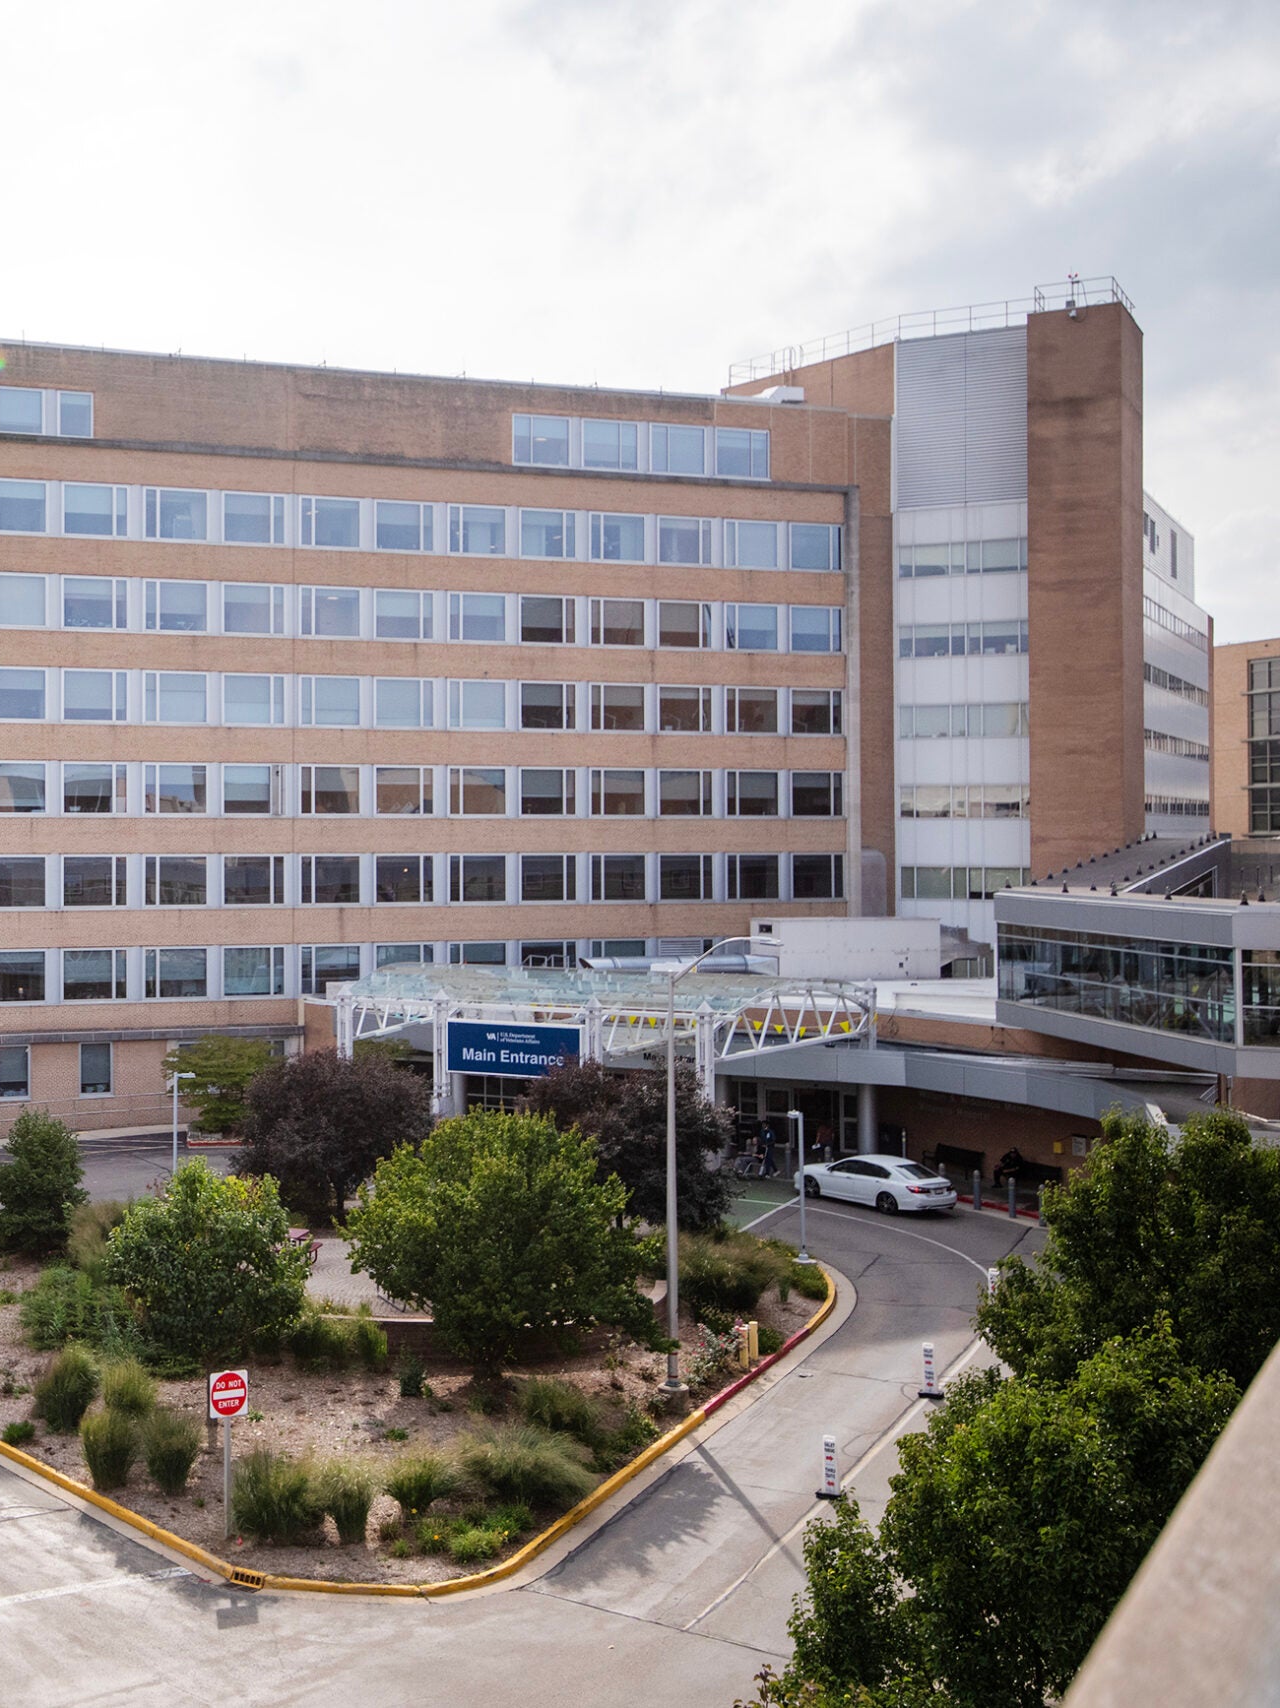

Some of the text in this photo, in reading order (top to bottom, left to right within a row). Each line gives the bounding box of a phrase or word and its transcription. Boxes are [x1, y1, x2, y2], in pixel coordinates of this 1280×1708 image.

[486, 1032, 497, 1041] VA
[462, 1048, 564, 1066] Main Entrance
[216, 1379, 242, 1389] DO NOT
[218, 1399, 239, 1408] ENTER
